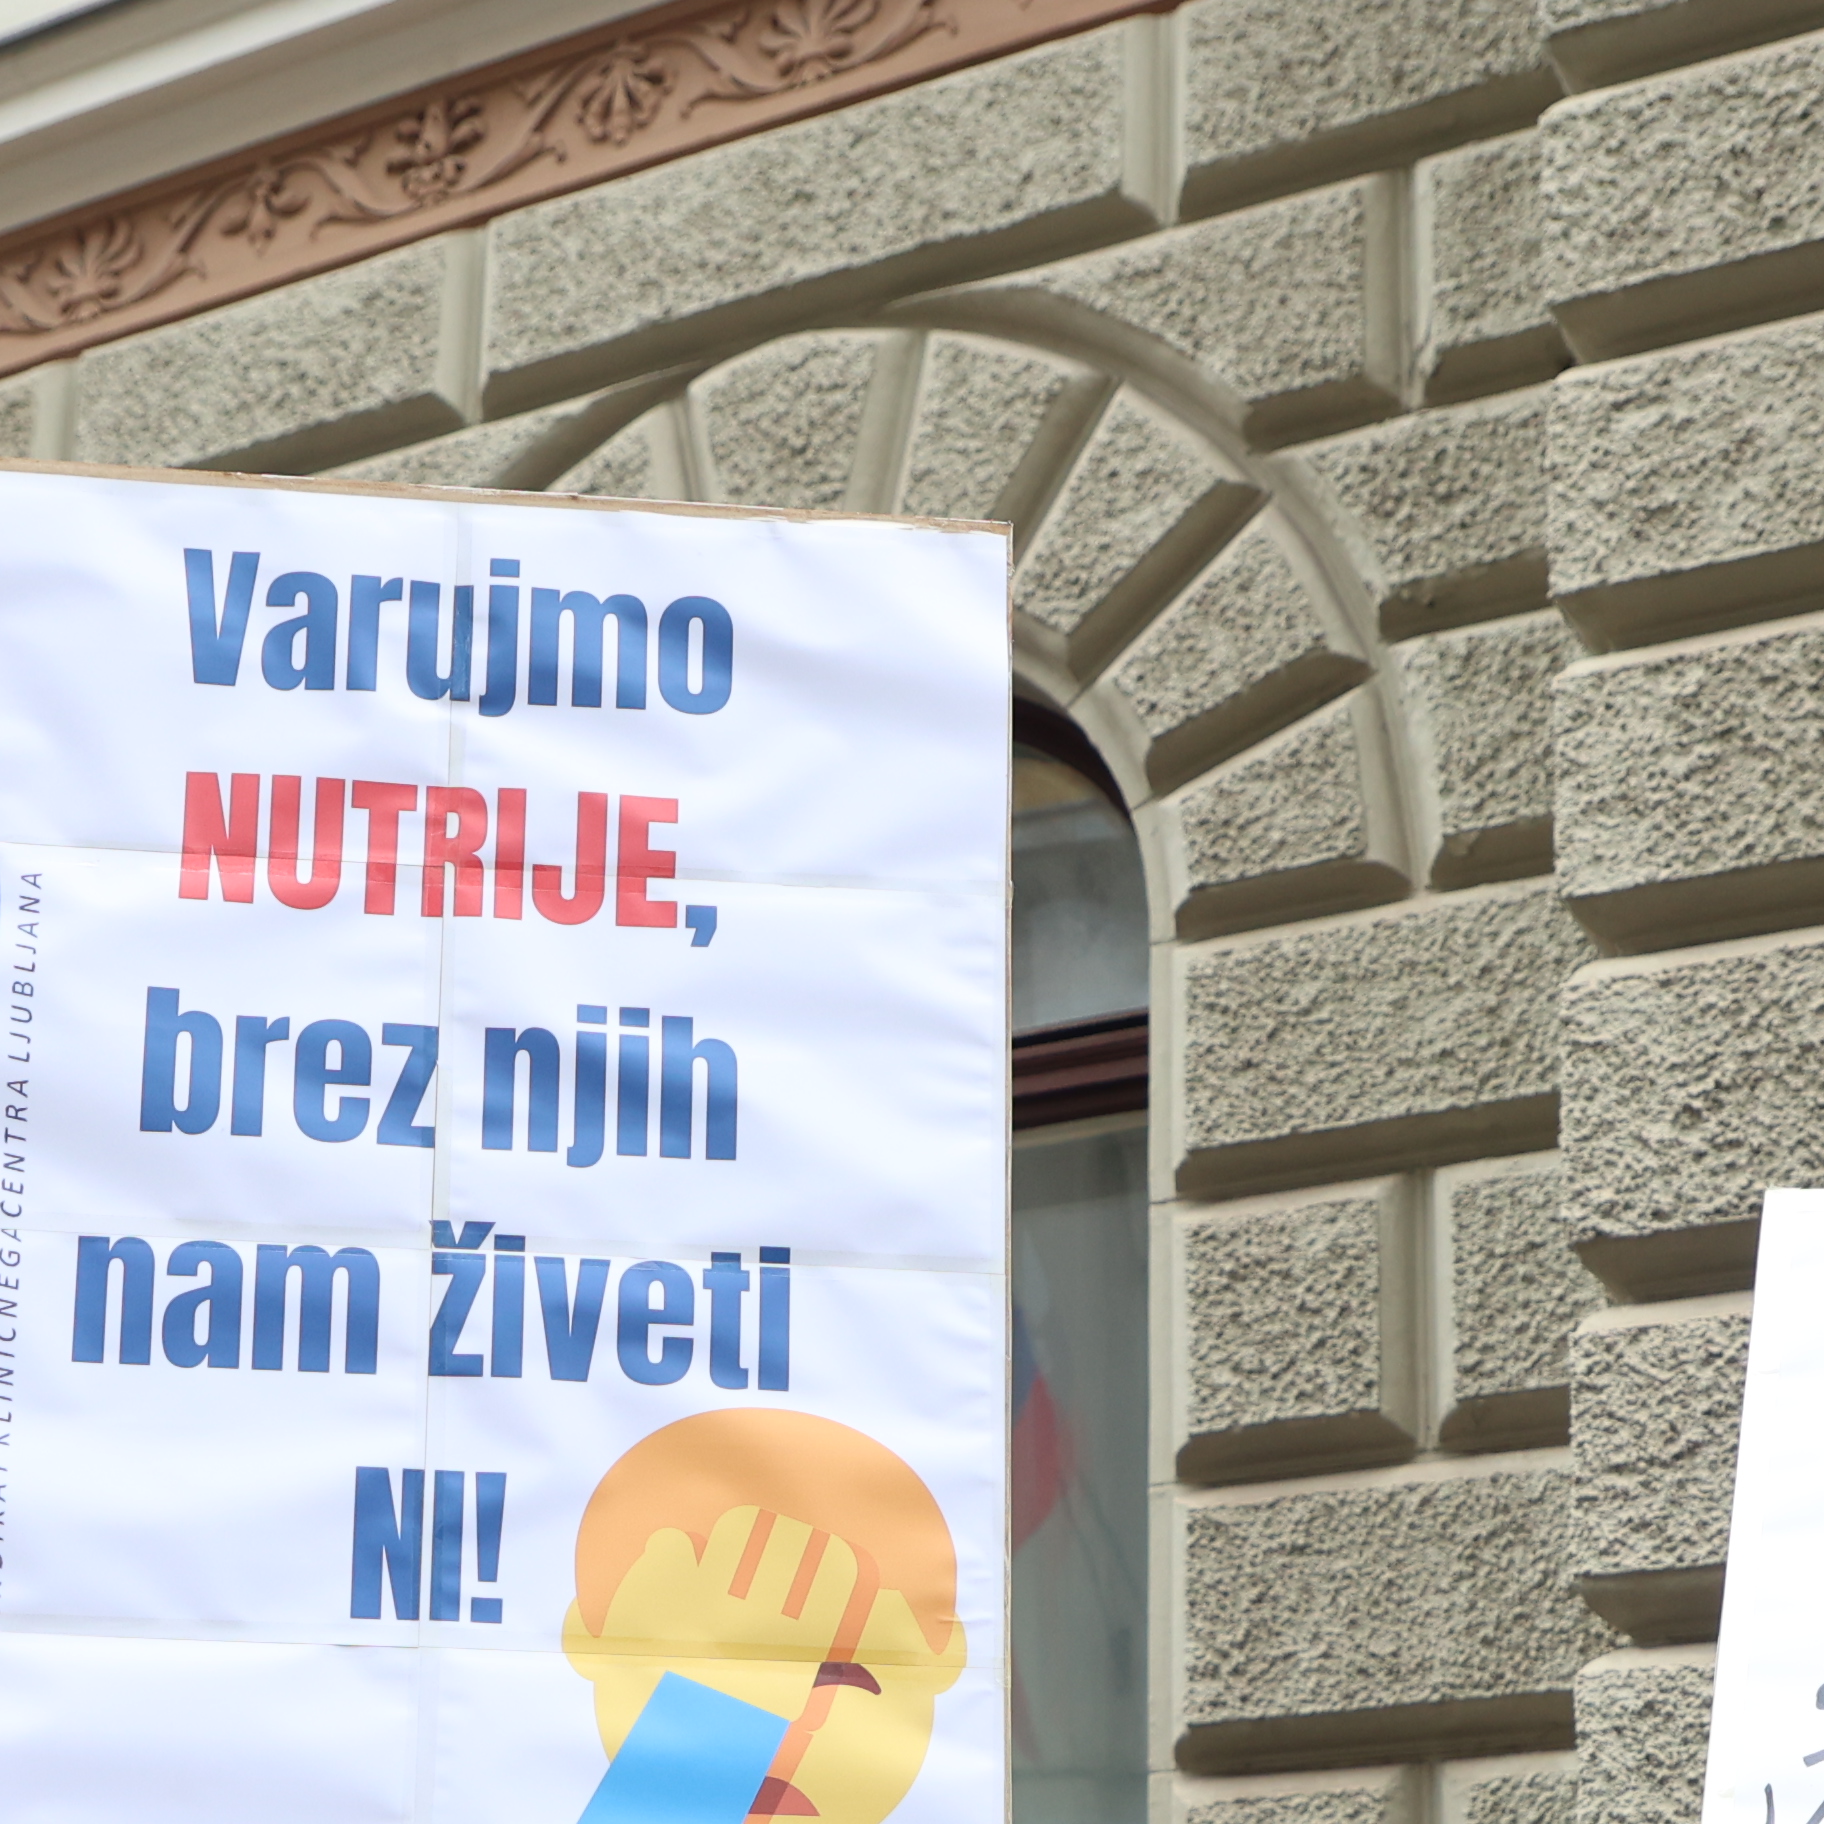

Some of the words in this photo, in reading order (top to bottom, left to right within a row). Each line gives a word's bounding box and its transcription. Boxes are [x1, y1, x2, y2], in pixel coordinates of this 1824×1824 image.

[182, 546, 734, 718] Varujmo
[178, 770, 718, 948] NUTRIJE,
[8, 872, 43, 1063] LJUBLJANA
[139, 985, 437, 1149] brez
[481, 1003, 738, 1168] njih
[71, 1234, 379, 1375] nam
[428, 1219, 791, 1393] živeti
[350, 1465, 507, 1623] NI!
